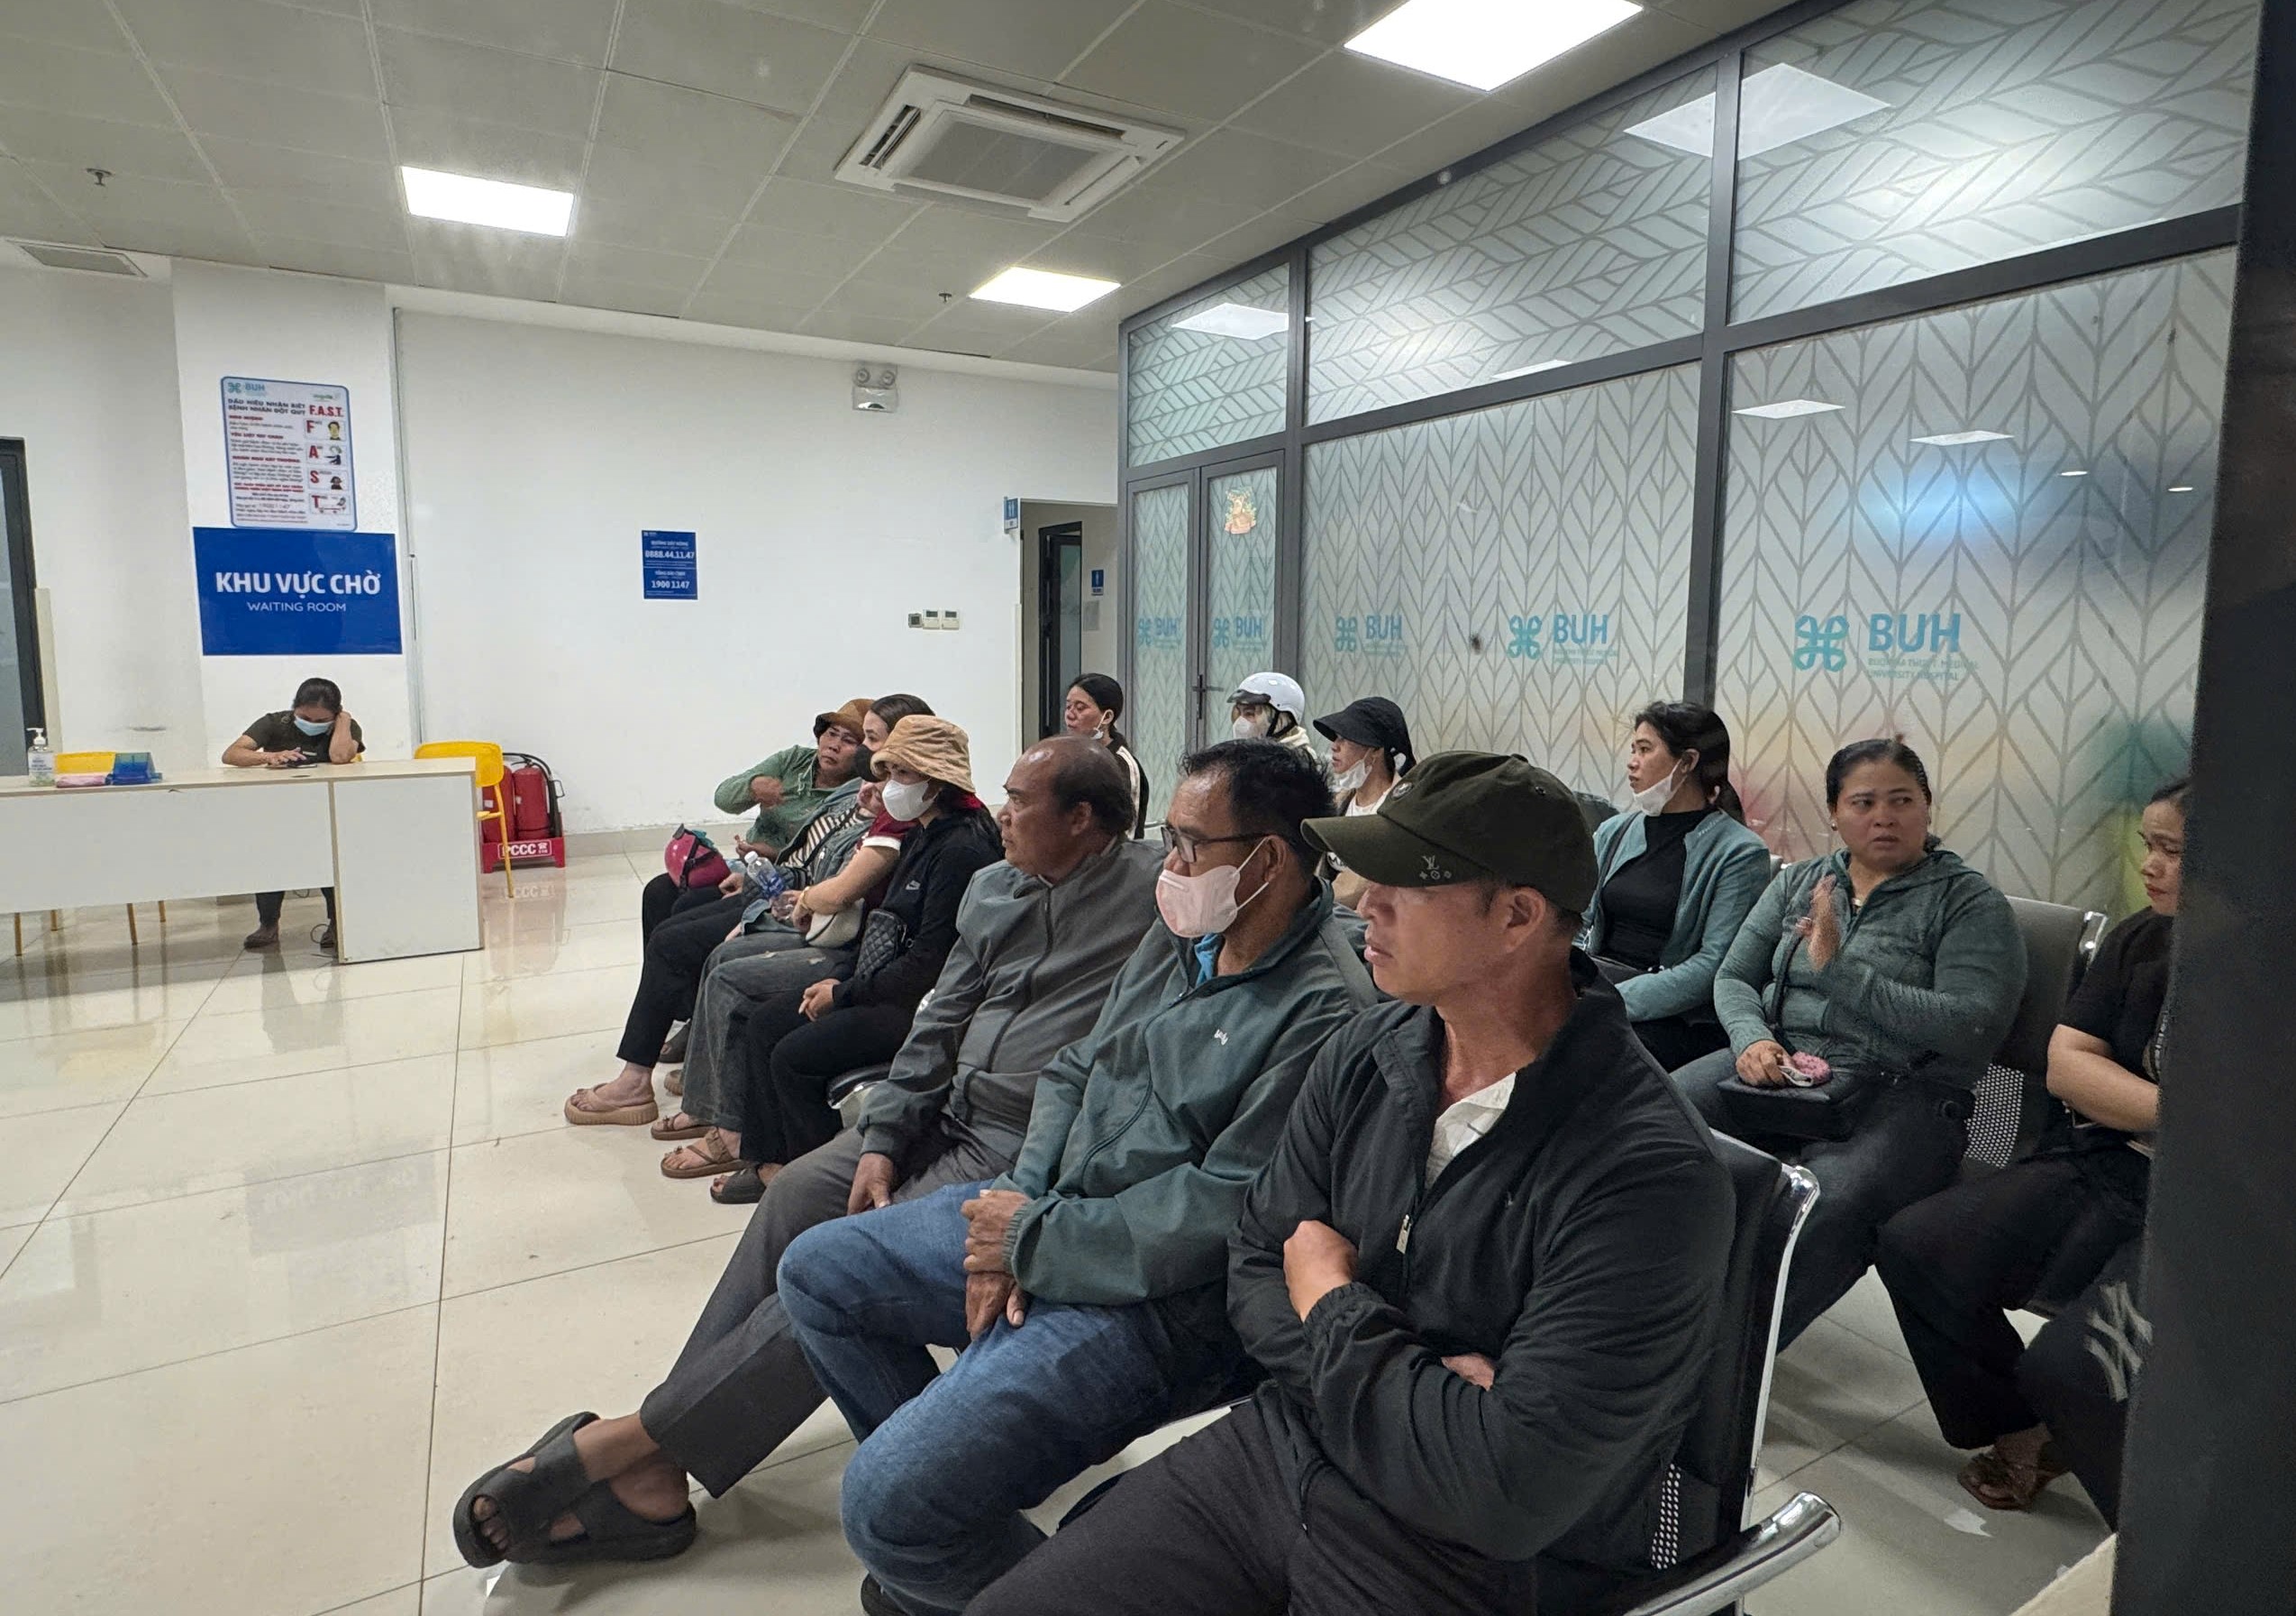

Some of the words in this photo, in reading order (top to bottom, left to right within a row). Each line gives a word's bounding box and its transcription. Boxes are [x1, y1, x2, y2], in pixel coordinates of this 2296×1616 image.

[245, 383, 265, 391] BUH
[215, 571, 270, 593] KHU
[276, 571, 325, 598] VỰC
[330, 570, 381, 595] CHỜ
[651, 580, 670, 589] 1900
[671, 580, 690, 589] 1147
[247, 602, 304, 612] WAITING
[307, 602, 346, 612] ROOM
[1155, 616, 1177, 636] BUH
[1235, 615, 1262, 638] BUH
[1366, 615, 1402, 640] BUH
[1553, 614, 1608, 644] BUH
[1869, 613, 1962, 653] BUH
